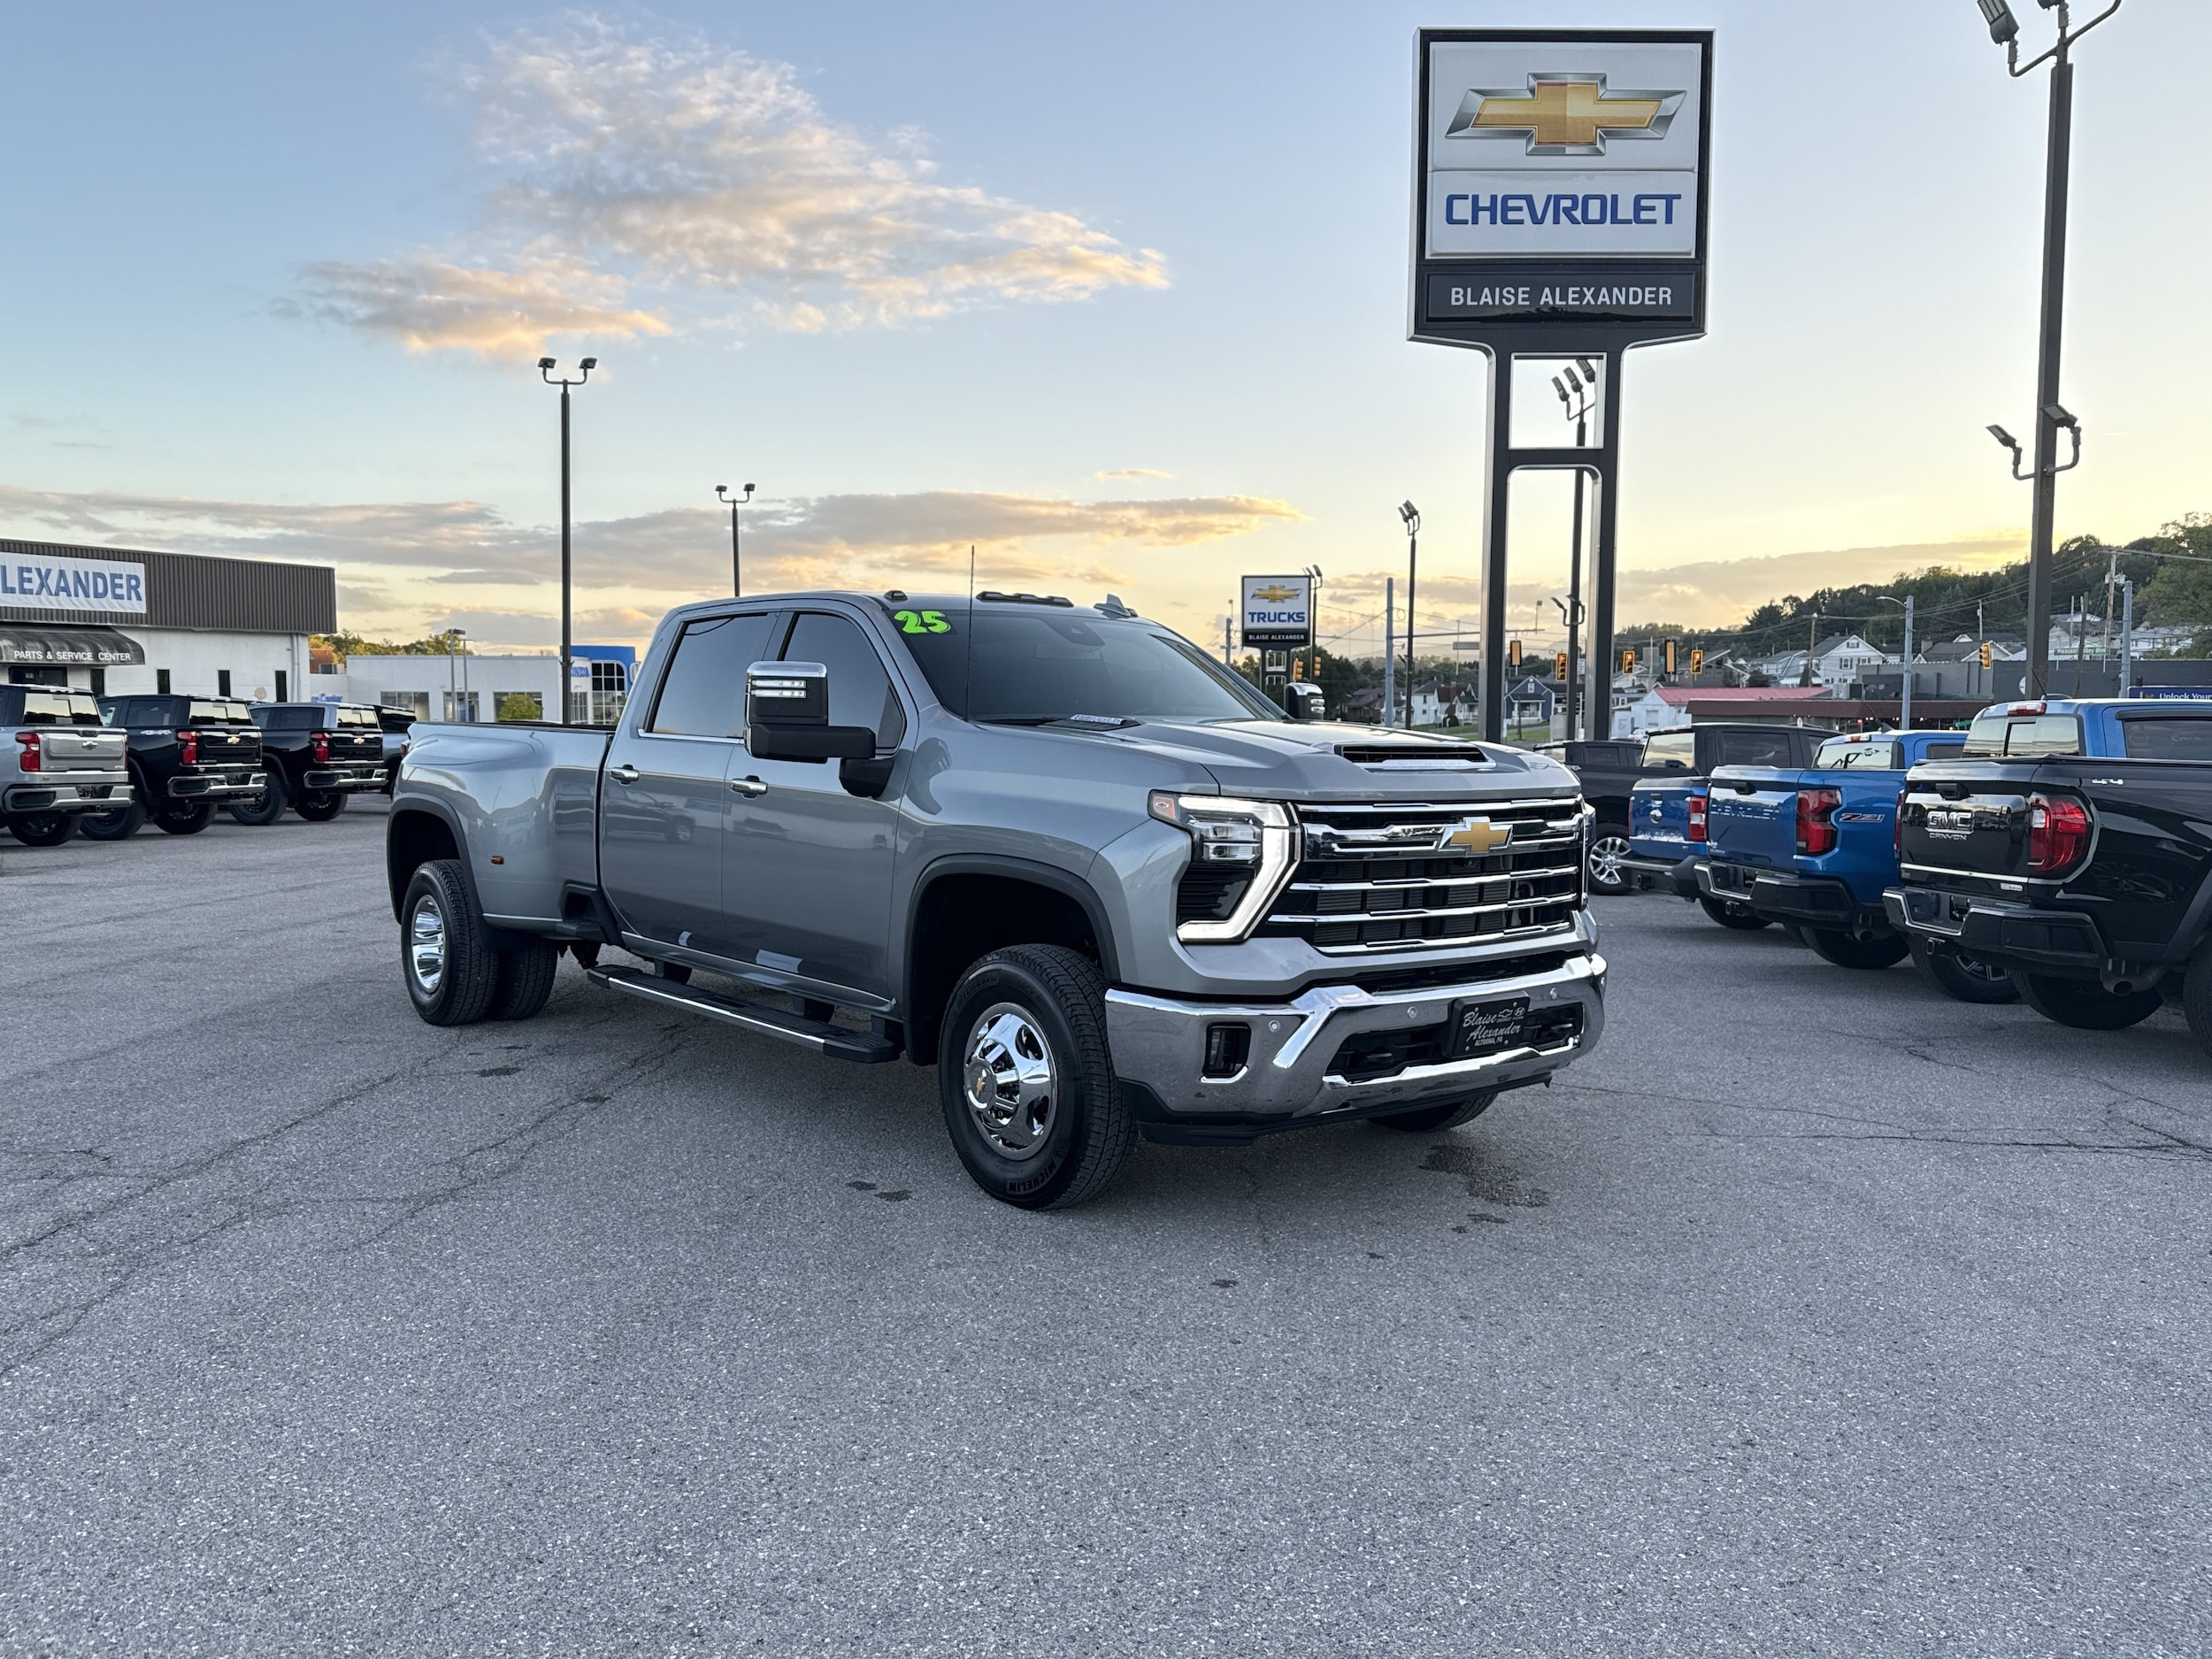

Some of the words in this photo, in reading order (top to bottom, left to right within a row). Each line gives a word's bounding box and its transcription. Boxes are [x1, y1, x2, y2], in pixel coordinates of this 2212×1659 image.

[1446, 193, 1681, 226] CHEVROLET
[1450, 287, 1531, 306] BLAISE
[1540, 286, 1672, 305] ALEXANDER
[894, 610, 951, 634] 25
[1248, 611, 1305, 623] TRUCKS
[13, 650, 42, 660] PARTS
[46, 651, 53, 660] &
[56, 651, 93, 661] SERVICE
[98, 652, 131, 661] CENTER
[1928, 810, 1973, 830] GMC
[1463, 1010, 1497, 1027] Blaise
[1466, 1022, 1521, 1042] Alexander
